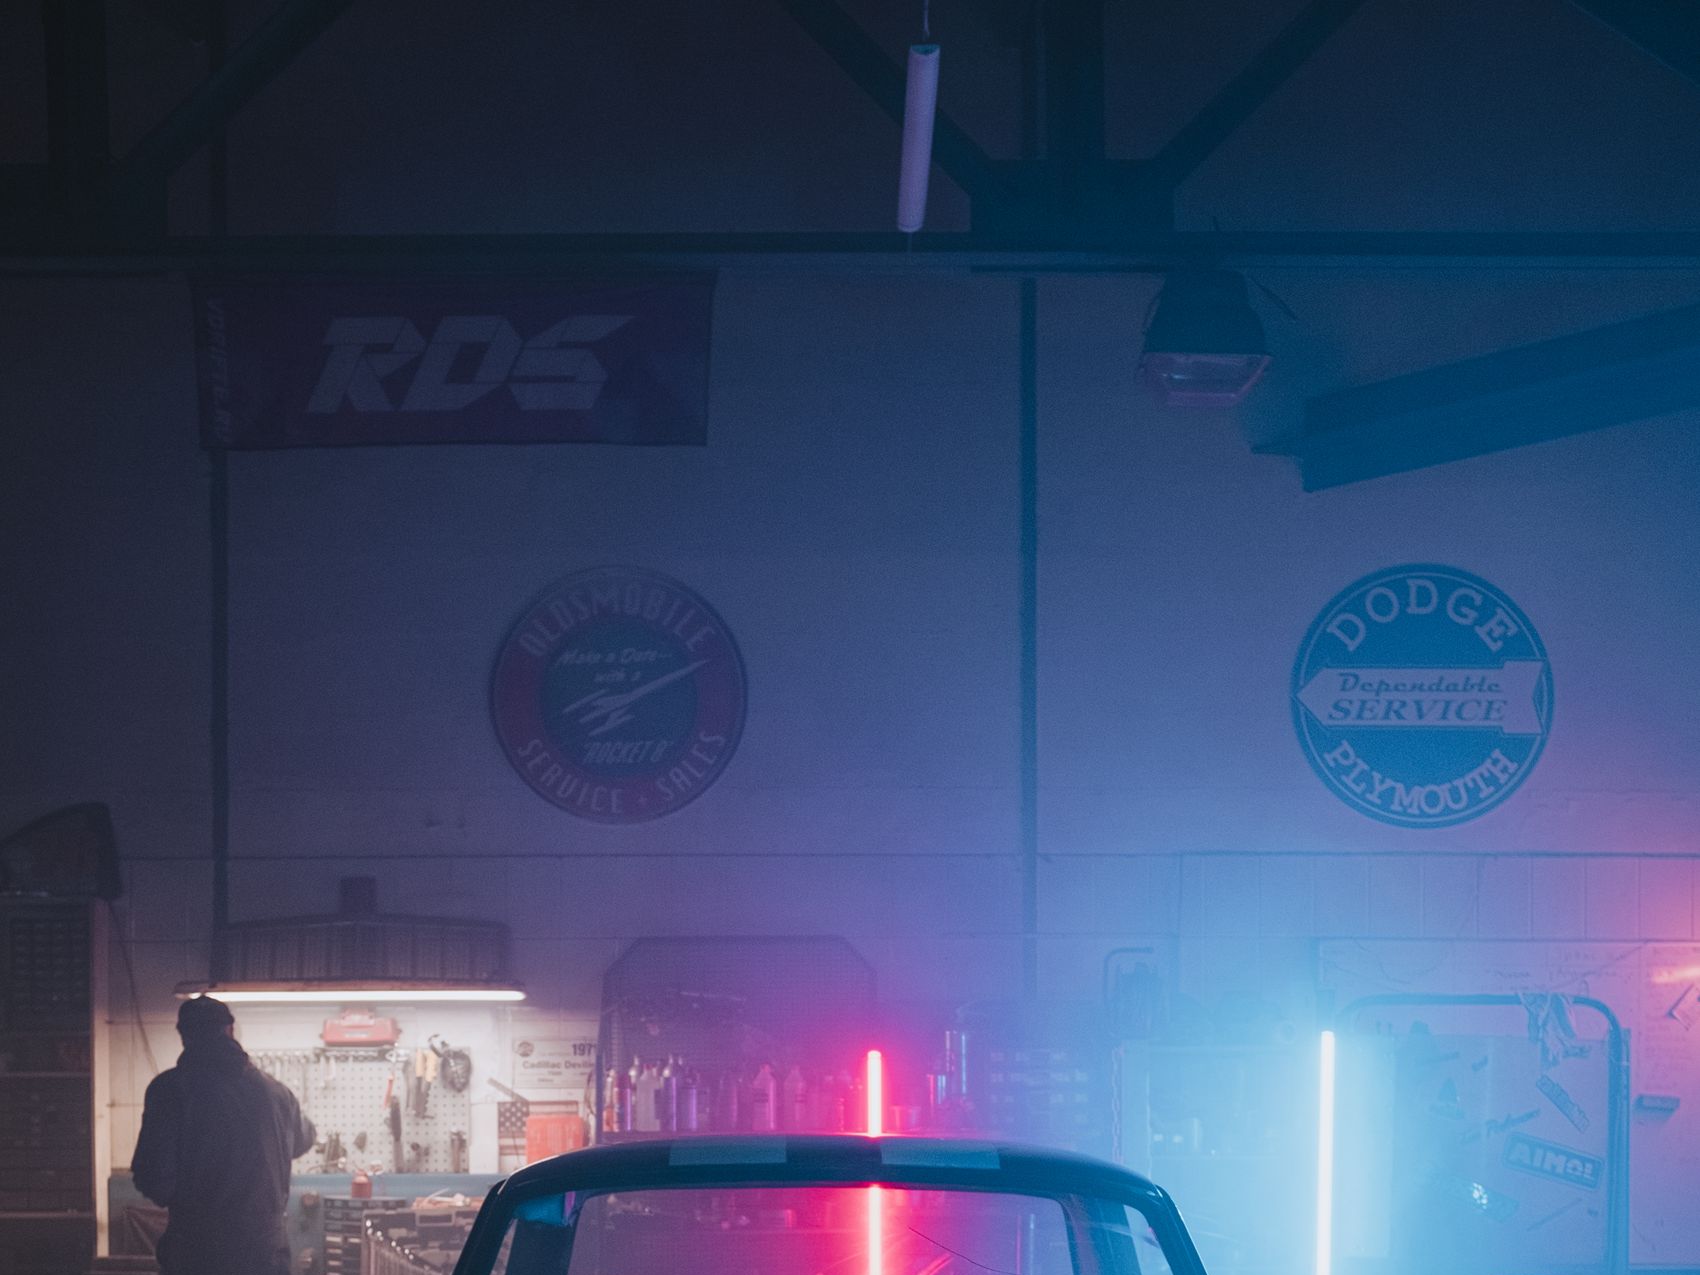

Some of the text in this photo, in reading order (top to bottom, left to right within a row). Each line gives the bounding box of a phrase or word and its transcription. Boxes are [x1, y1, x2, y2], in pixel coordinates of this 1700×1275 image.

[307, 315, 638, 413] RDS
[518, 583, 717, 658] OLDSMOBILE
[1326, 578, 1519, 651] DODGE
[1328, 699, 1508, 721] SERVICE
[1338, 672, 1501, 696] Dependable
[517, 729, 728, 814] SERVICE SALES
[1323, 740, 1519, 814] PLYMOUTH
[572, 1043, 597, 1056] 197
